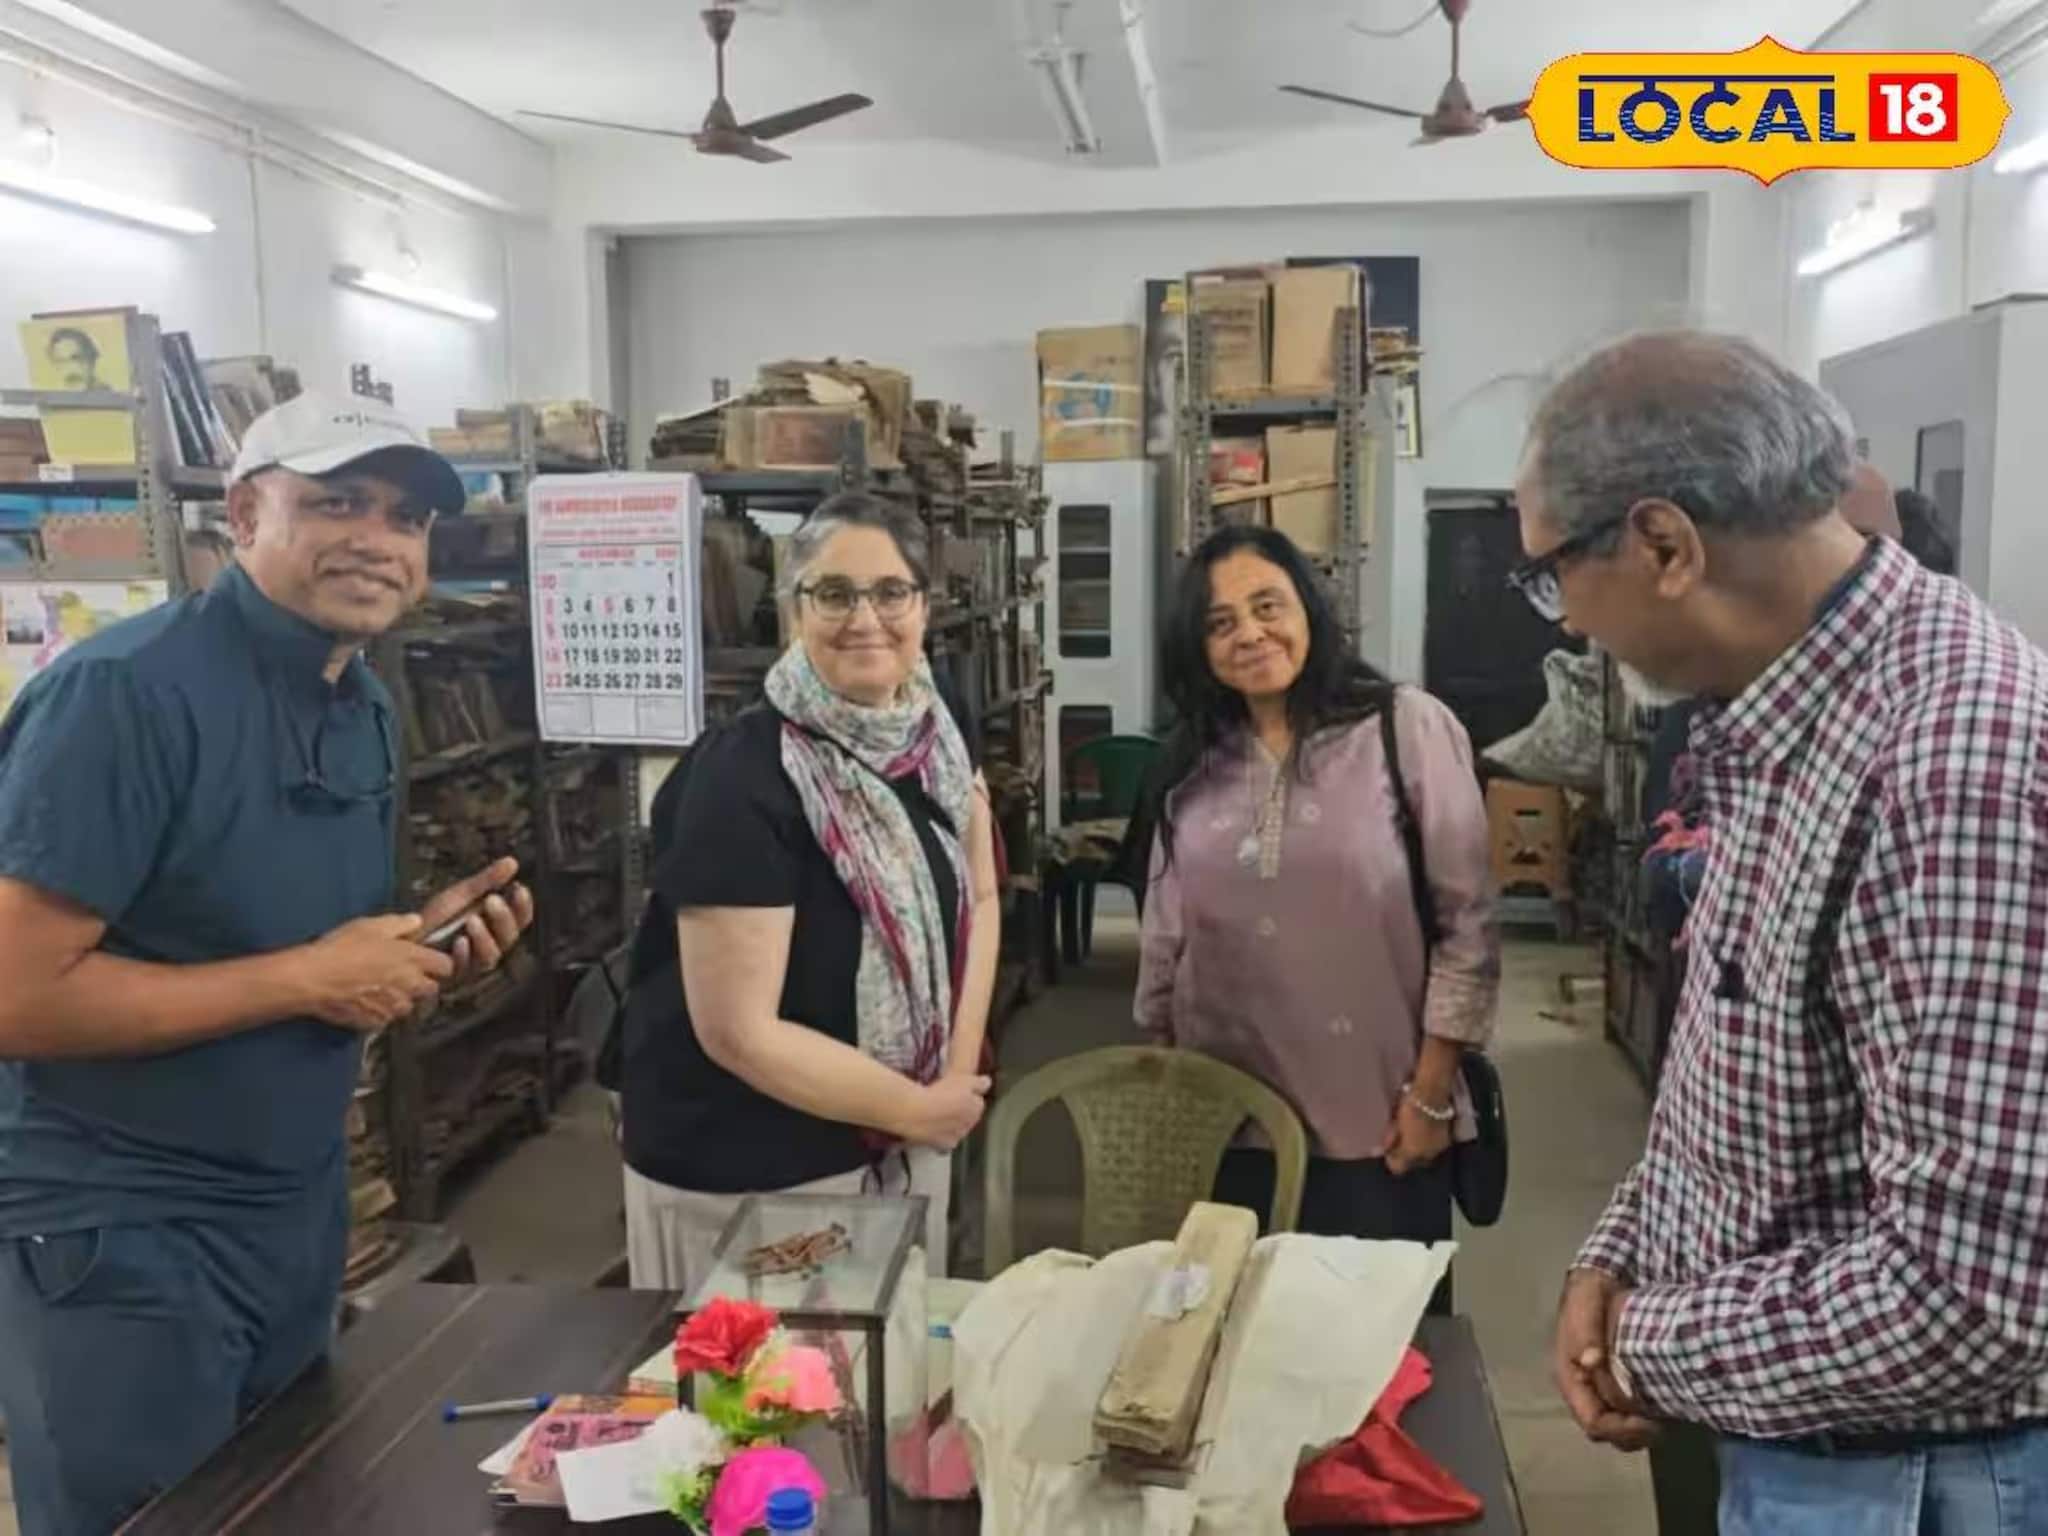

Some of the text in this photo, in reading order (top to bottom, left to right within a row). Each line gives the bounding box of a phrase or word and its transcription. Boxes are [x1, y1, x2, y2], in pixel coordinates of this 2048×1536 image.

[563, 623, 578, 638] 10
[582, 623, 597, 638] 11
[602, 623, 618, 639] 12
[623, 623, 639, 638] 13
[643, 622, 660, 638] 14
[665, 622, 681, 638] 15
[564, 648, 579, 664] 17
[603, 648, 620, 663] 19
[624, 648, 641, 663] 20
[645, 648, 659, 663] 21
[665, 648, 682, 664] 22
[564, 673, 580, 688] 24
[584, 673, 600, 689] 25
[604, 673, 621, 689] 26
[625, 673, 640, 689] 27
[645, 673, 662, 689] 28
[665, 673, 683, 689] 29
